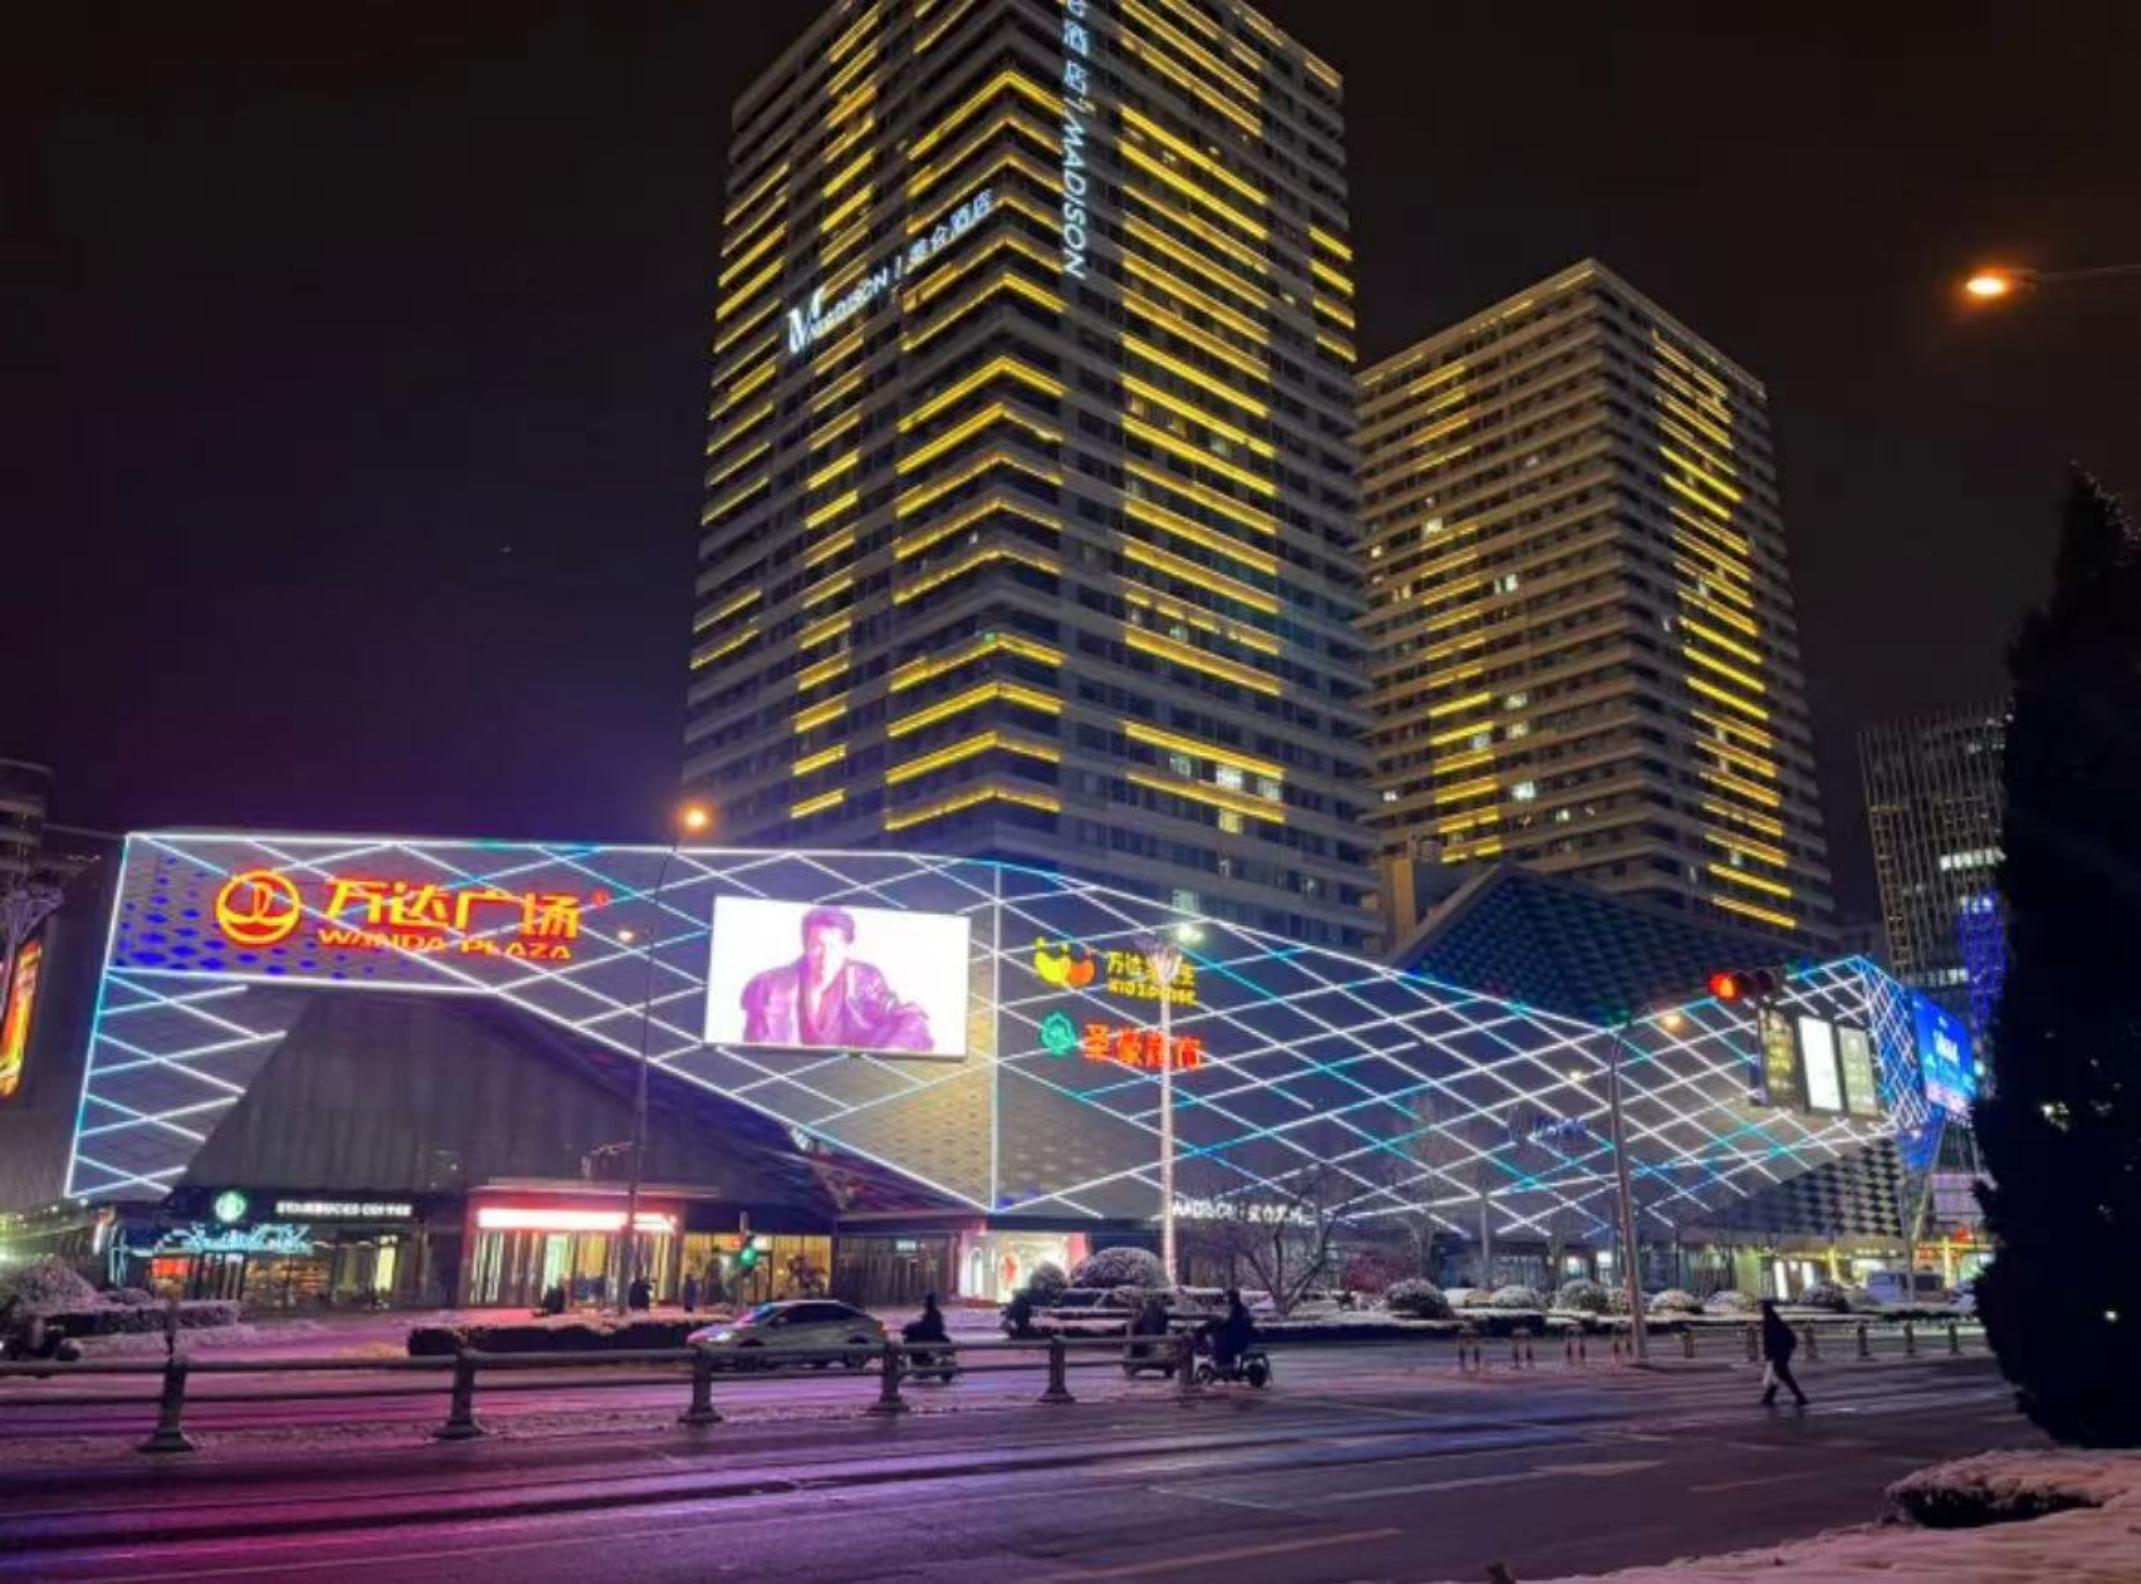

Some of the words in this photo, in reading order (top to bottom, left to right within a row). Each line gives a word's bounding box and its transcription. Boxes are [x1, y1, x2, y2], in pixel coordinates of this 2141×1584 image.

[1063, 108, 1088, 280] MADISON
[325, 879, 581, 939] 万达广场
[318, 928, 449, 952] WANDA
[460, 939, 572, 960] PLAZA
